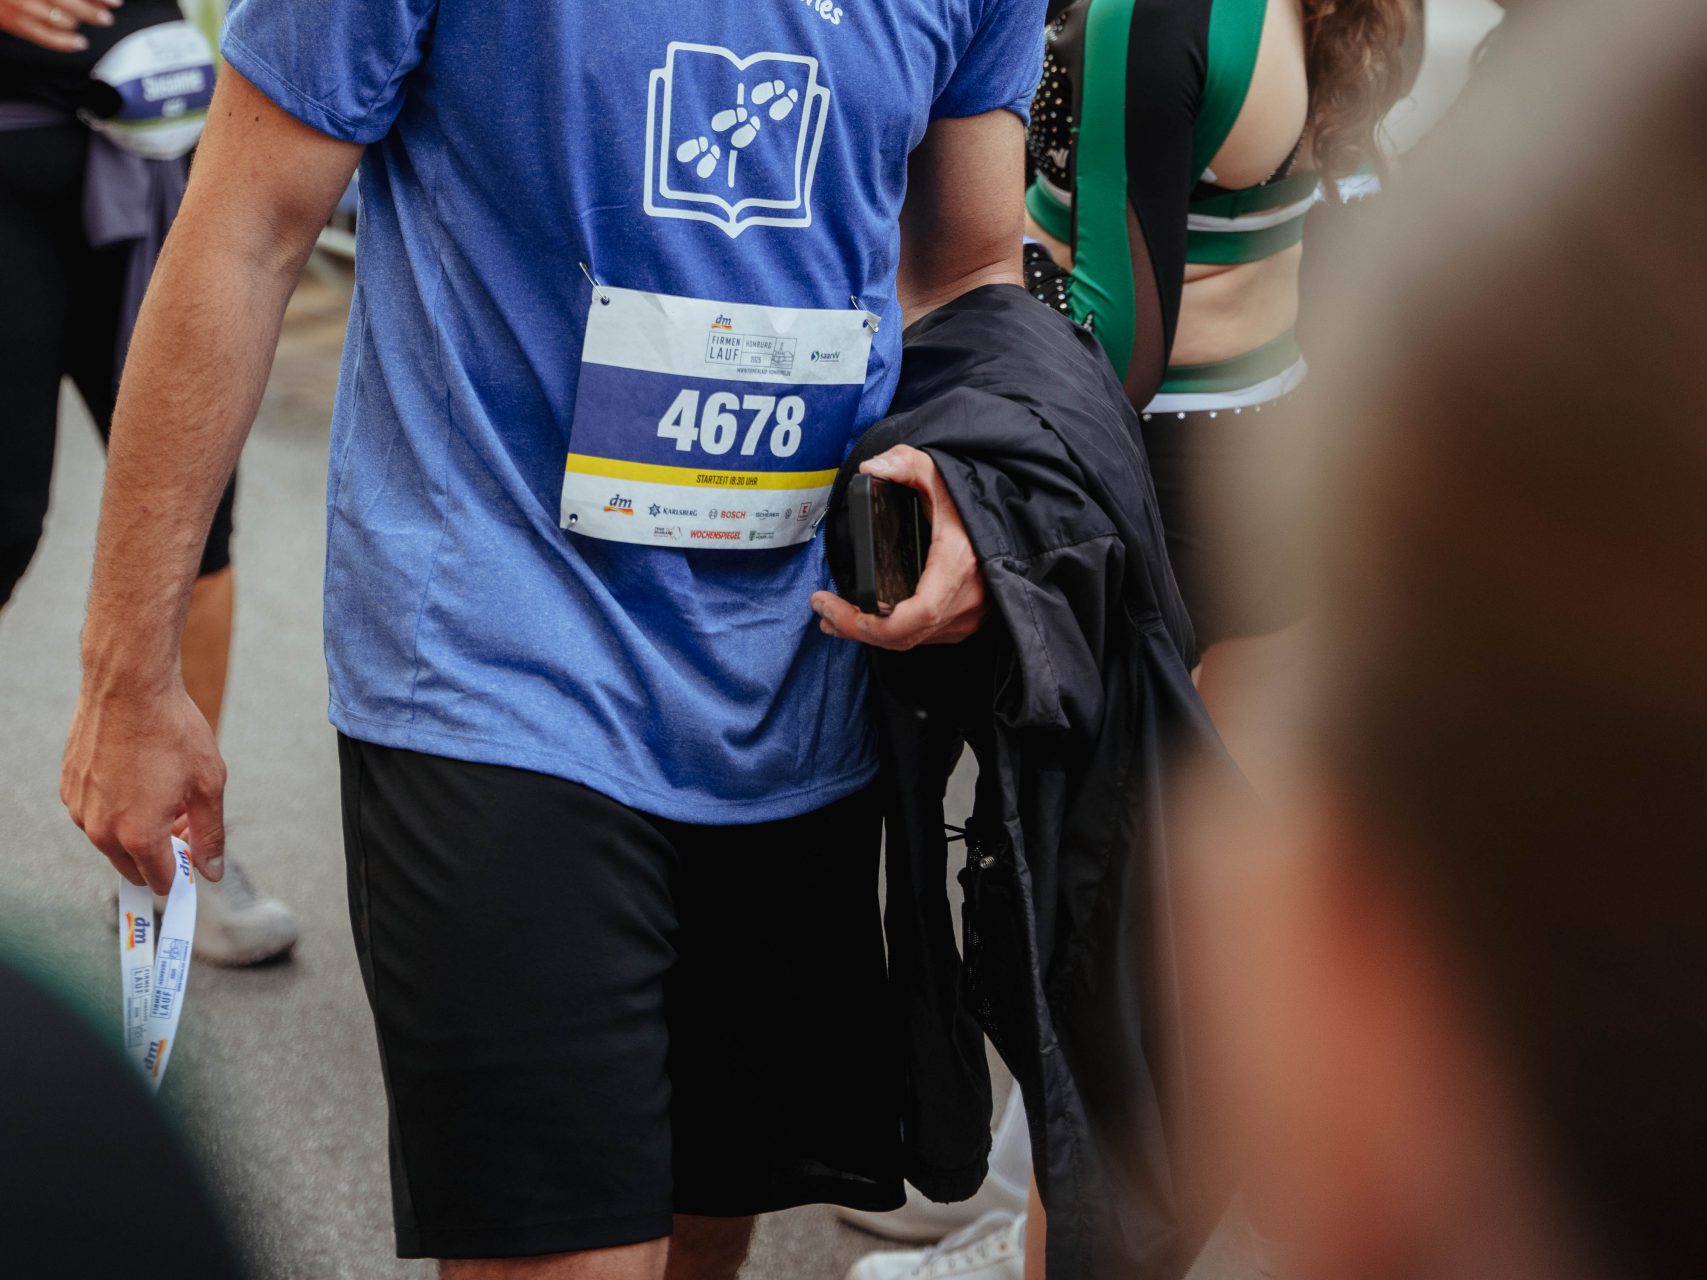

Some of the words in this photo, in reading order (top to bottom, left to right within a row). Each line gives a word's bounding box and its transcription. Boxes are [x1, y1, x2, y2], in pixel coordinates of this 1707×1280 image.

[711, 335, 741, 347] FIRMEN
[709, 347, 740, 361] LAUF
[656, 388, 806, 458] 4678
[696, 474, 728, 486] STARTZEIT
[745, 476, 758, 486] UHR
[662, 507, 698, 517] KARLSBERG
[720, 510, 746, 519] BOSCH
[690, 530, 741, 540] WOCHENSPIEGEL
[134, 916, 150, 944] dm
[151, 989, 162, 1016] FIRMEN
[160, 992, 172, 1016] LAUF
